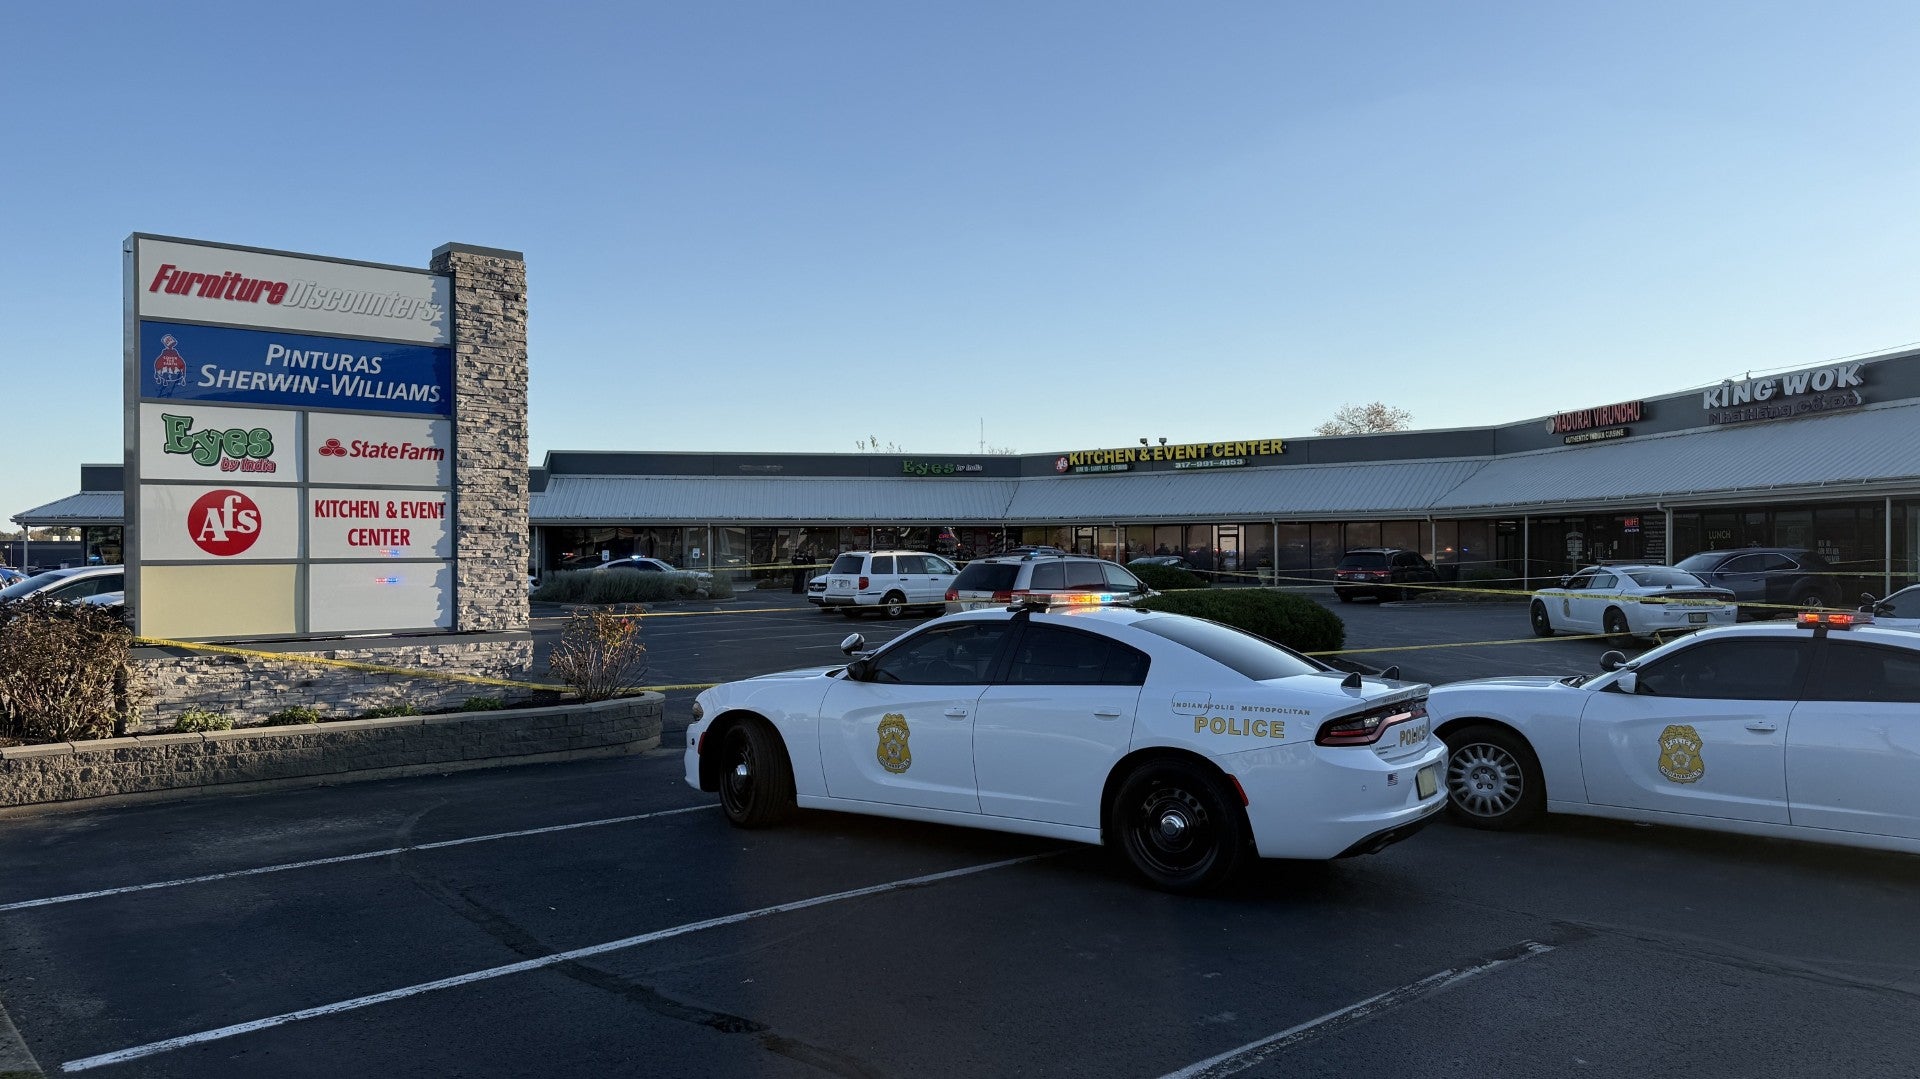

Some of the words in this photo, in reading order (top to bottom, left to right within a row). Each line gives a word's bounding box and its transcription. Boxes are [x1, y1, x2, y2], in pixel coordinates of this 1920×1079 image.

[149, 263, 288, 305] Furniture
[281, 278, 443, 321] Discounters
[265, 343, 382, 375] PINTURAS
[198, 364, 441, 403] SHERWIN-WILLIAMS
[1703, 380, 1777, 409] KING
[1782, 364, 1864, 396] WOK
[1555, 408, 1592, 433] MADURAI
[1592, 401, 1641, 428] VIRUNDHU
[161, 413, 275, 466] Eyes
[220, 457, 240, 473] by
[240, 457, 277, 473] India
[1069, 449, 1136, 466] KITCHEN
[1139, 447, 1151, 462] &
[1154, 444, 1209, 461] EVENT
[1212, 439, 1284, 458] CENTER
[902, 460, 955, 475] Eyes
[197, 495, 258, 541] Afs
[315, 499, 379, 519] KITCHEN
[385, 502, 398, 518] &
[401, 502, 446, 520] EVENT
[348, 528, 411, 546] CENTER
[1708, 529, 1731, 540] LUNCH
[1172, 701, 1235, 711] INDIANAPOLIS
[1241, 705, 1311, 716] METROPOLITAN
[1194, 716, 1285, 739] POLICE
[1400, 724, 1427, 747] POLICE
